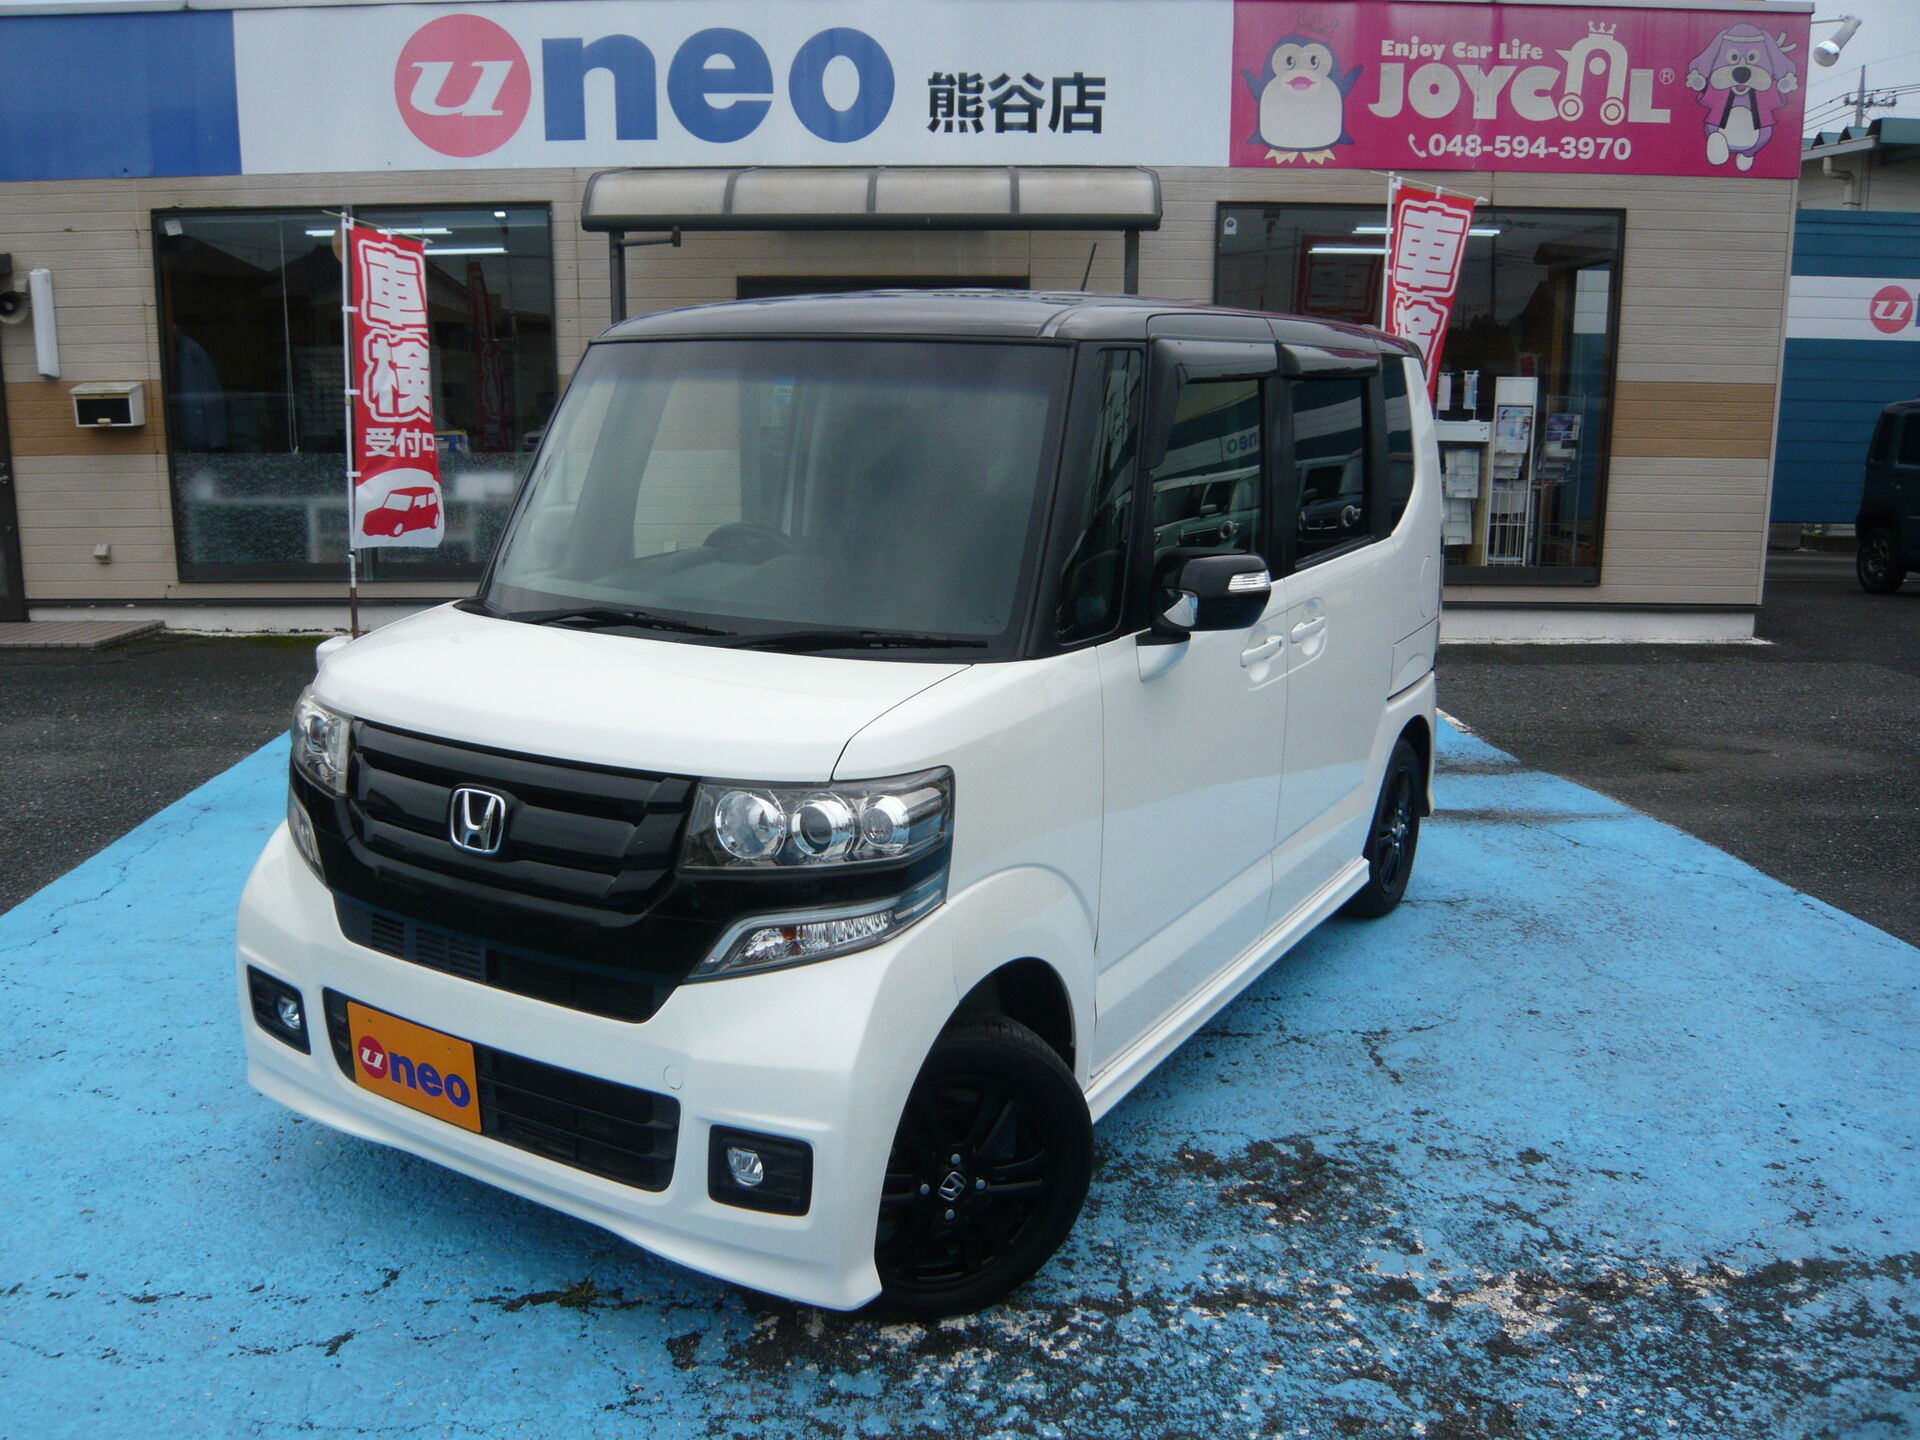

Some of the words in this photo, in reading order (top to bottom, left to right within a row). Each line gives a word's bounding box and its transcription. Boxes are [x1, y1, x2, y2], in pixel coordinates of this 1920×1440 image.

[1381, 36, 1446, 60] Enjoy
[1452, 41, 1493, 59] Car
[1499, 38, 1544, 60] Life
[926, 71, 1107, 135] 熊谷店
[1428, 133, 1632, 160] 048-594-3970
[359, 239, 431, 423] 車検
